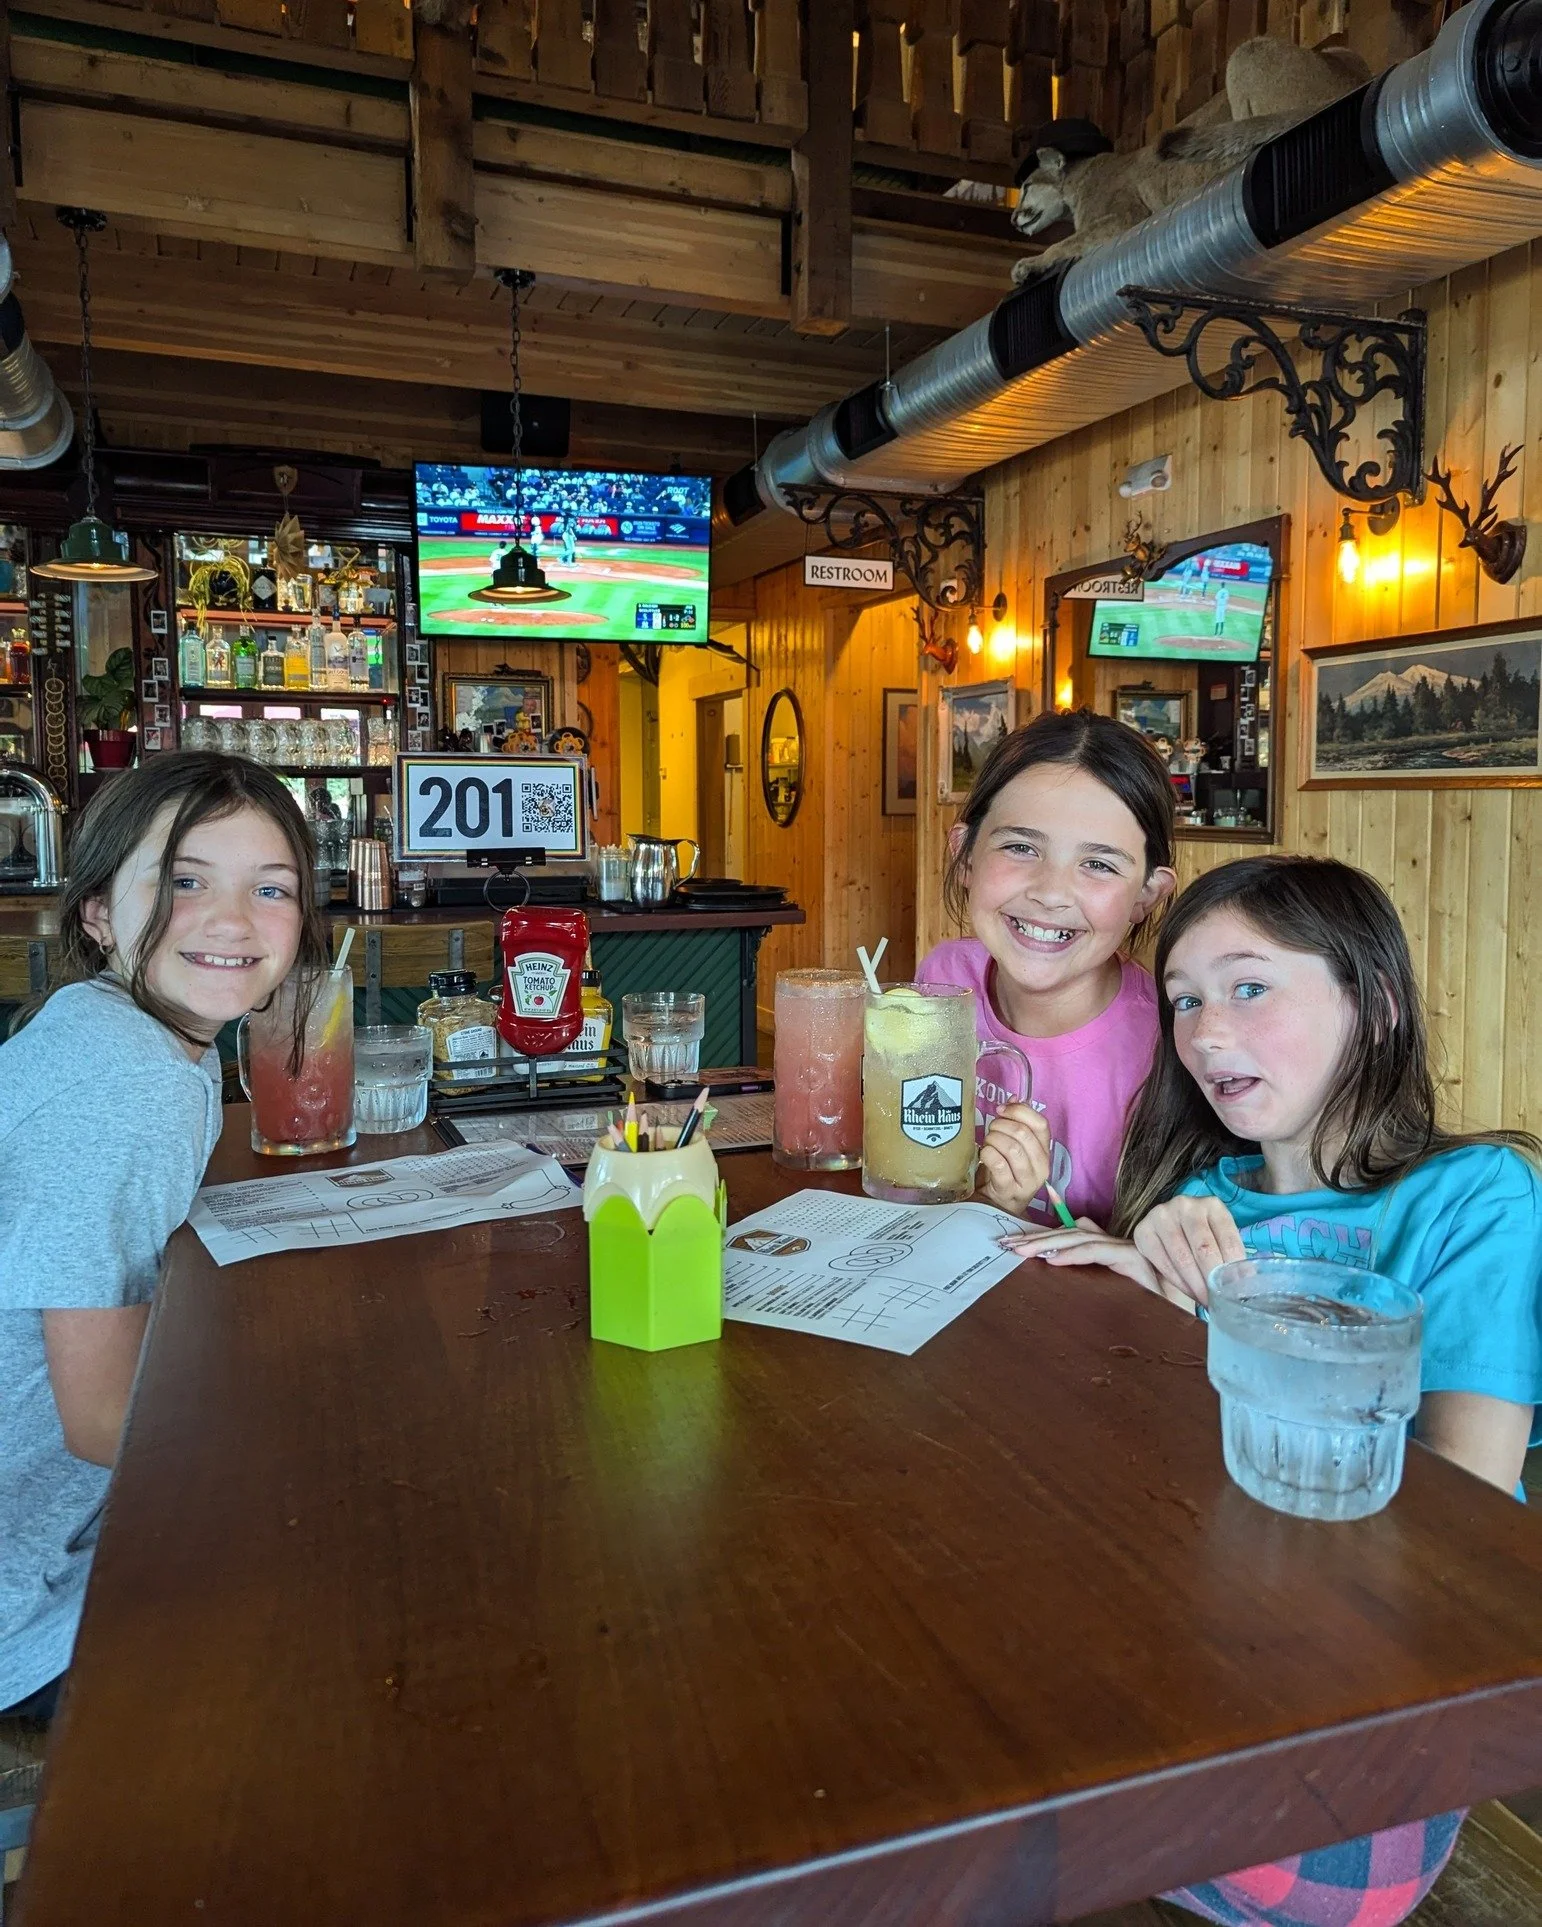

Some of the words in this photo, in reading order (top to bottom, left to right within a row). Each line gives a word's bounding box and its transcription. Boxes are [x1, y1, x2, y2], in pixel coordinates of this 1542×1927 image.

[429, 516, 458, 524] TOYOTA
[811, 565, 888, 583] RESTROOM
[419, 776, 514, 839] 201
[525, 962, 554, 973] HEINZ
[522, 976, 556, 985] TOMATO
[524, 983, 554, 991] KETCHUP
[904, 1109, 936, 1124] Rhein
[938, 1109, 961, 1123] Häus
